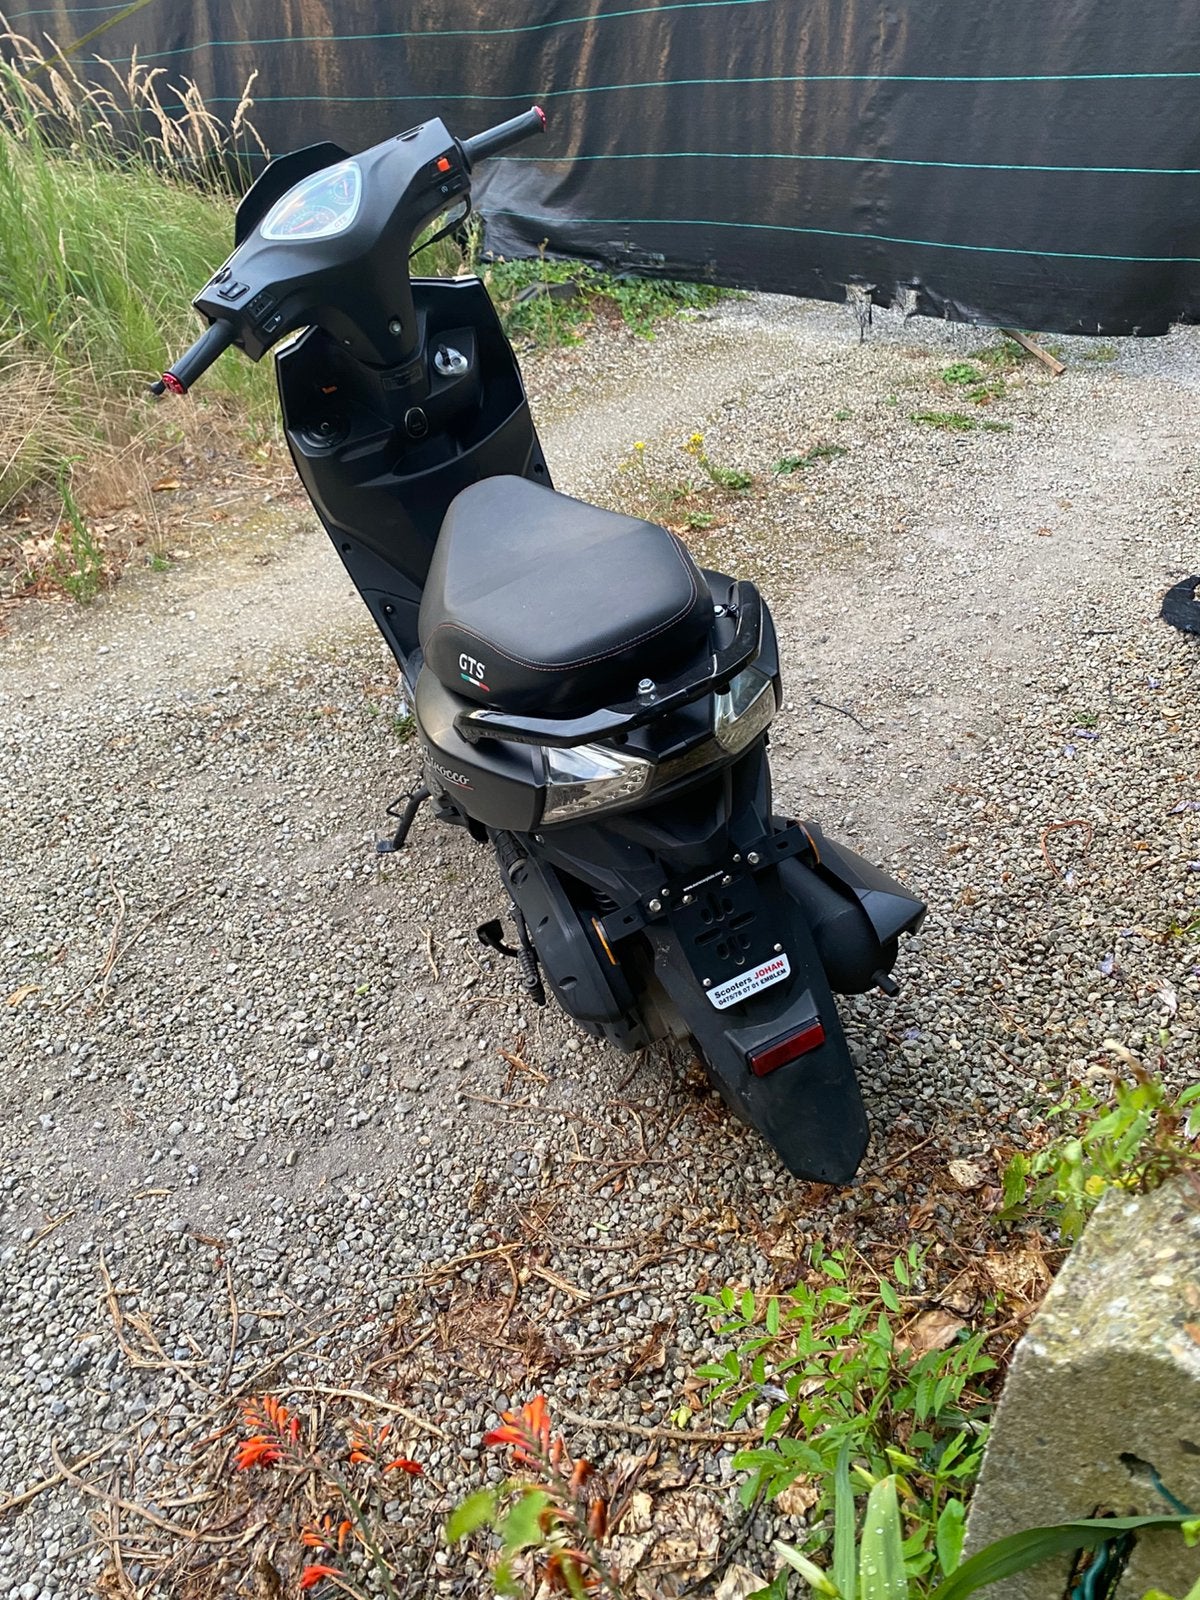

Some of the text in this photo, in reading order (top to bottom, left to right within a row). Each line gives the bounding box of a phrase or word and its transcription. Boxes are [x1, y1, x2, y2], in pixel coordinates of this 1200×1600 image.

[459, 653, 485, 679] GTS
[714, 960, 784, 999] Scooters JOHAN
[760, 968, 787, 985] EMBLEM
